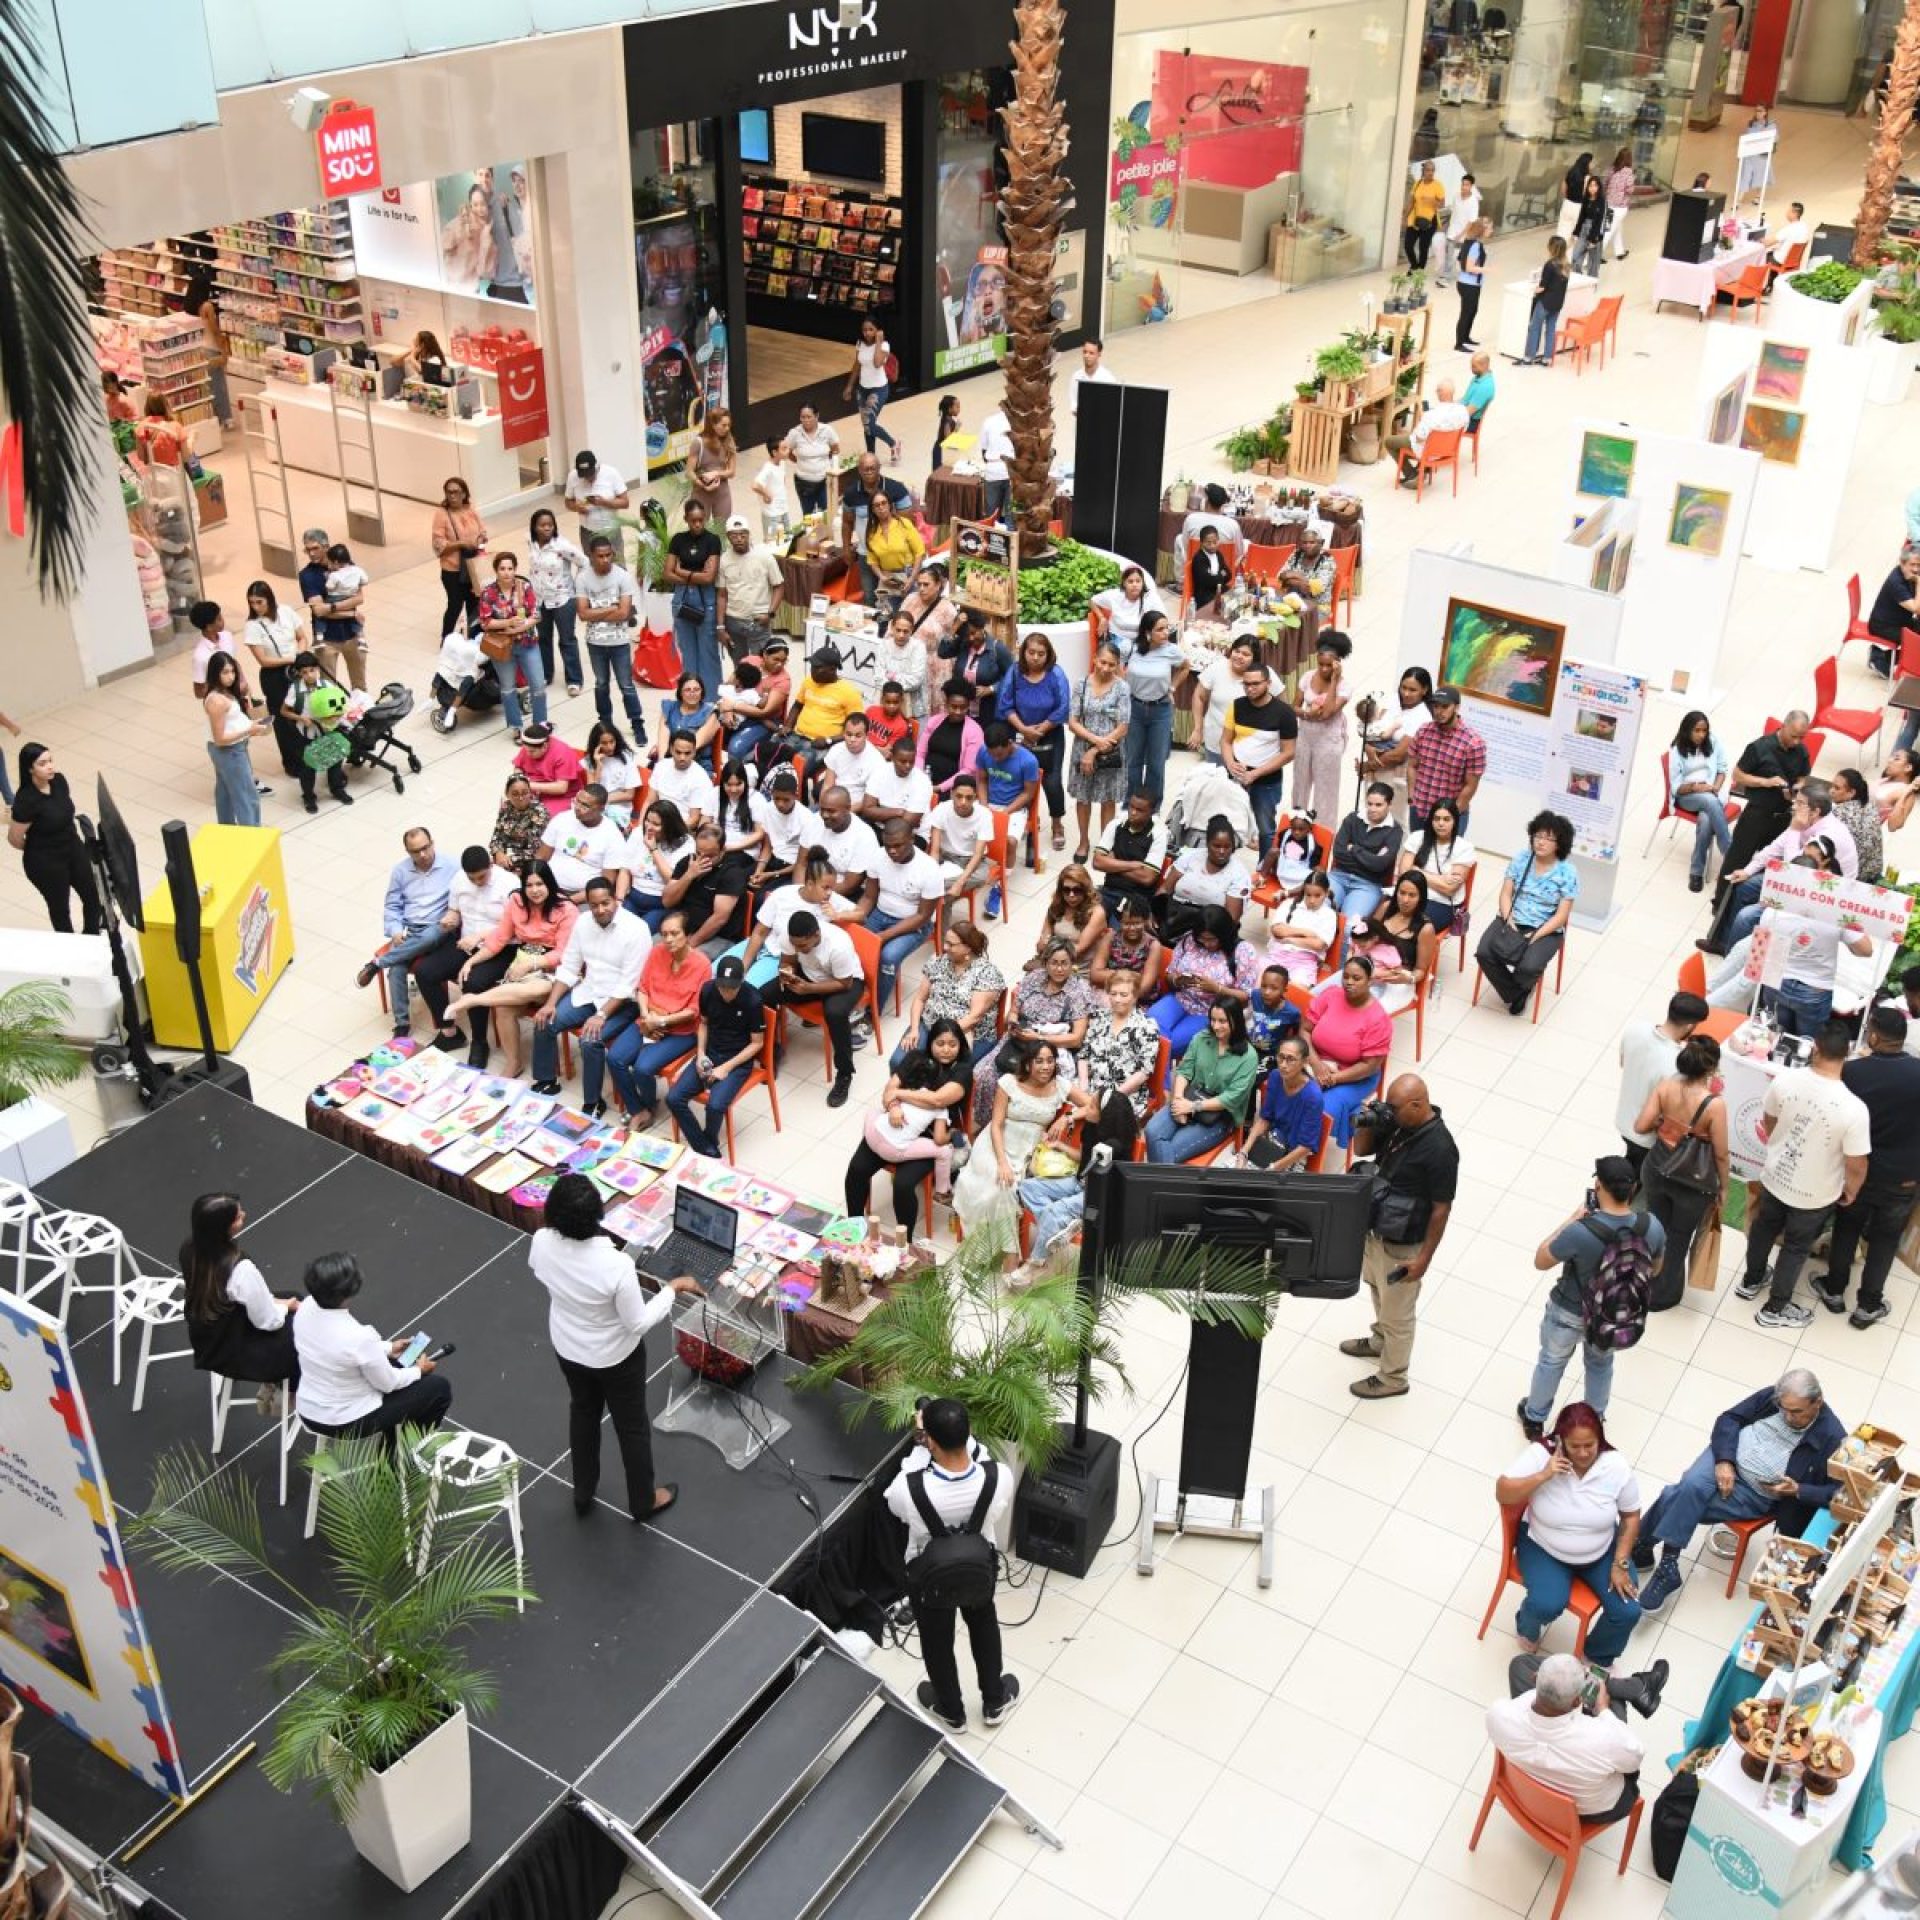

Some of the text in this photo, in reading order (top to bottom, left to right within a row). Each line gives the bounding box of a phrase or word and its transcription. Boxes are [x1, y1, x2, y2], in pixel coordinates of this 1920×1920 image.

[788, 0, 878, 50] NYX
[757, 49, 907, 84] PROFESSIONAL MAKEUP
[324, 125, 372, 154] MINI
[1116, 156, 1177, 184] petite jolie
[1766, 879, 1806, 897] FRESAS
[1809, 892, 1836, 906] CON
[1889, 913, 1905, 924] RD
